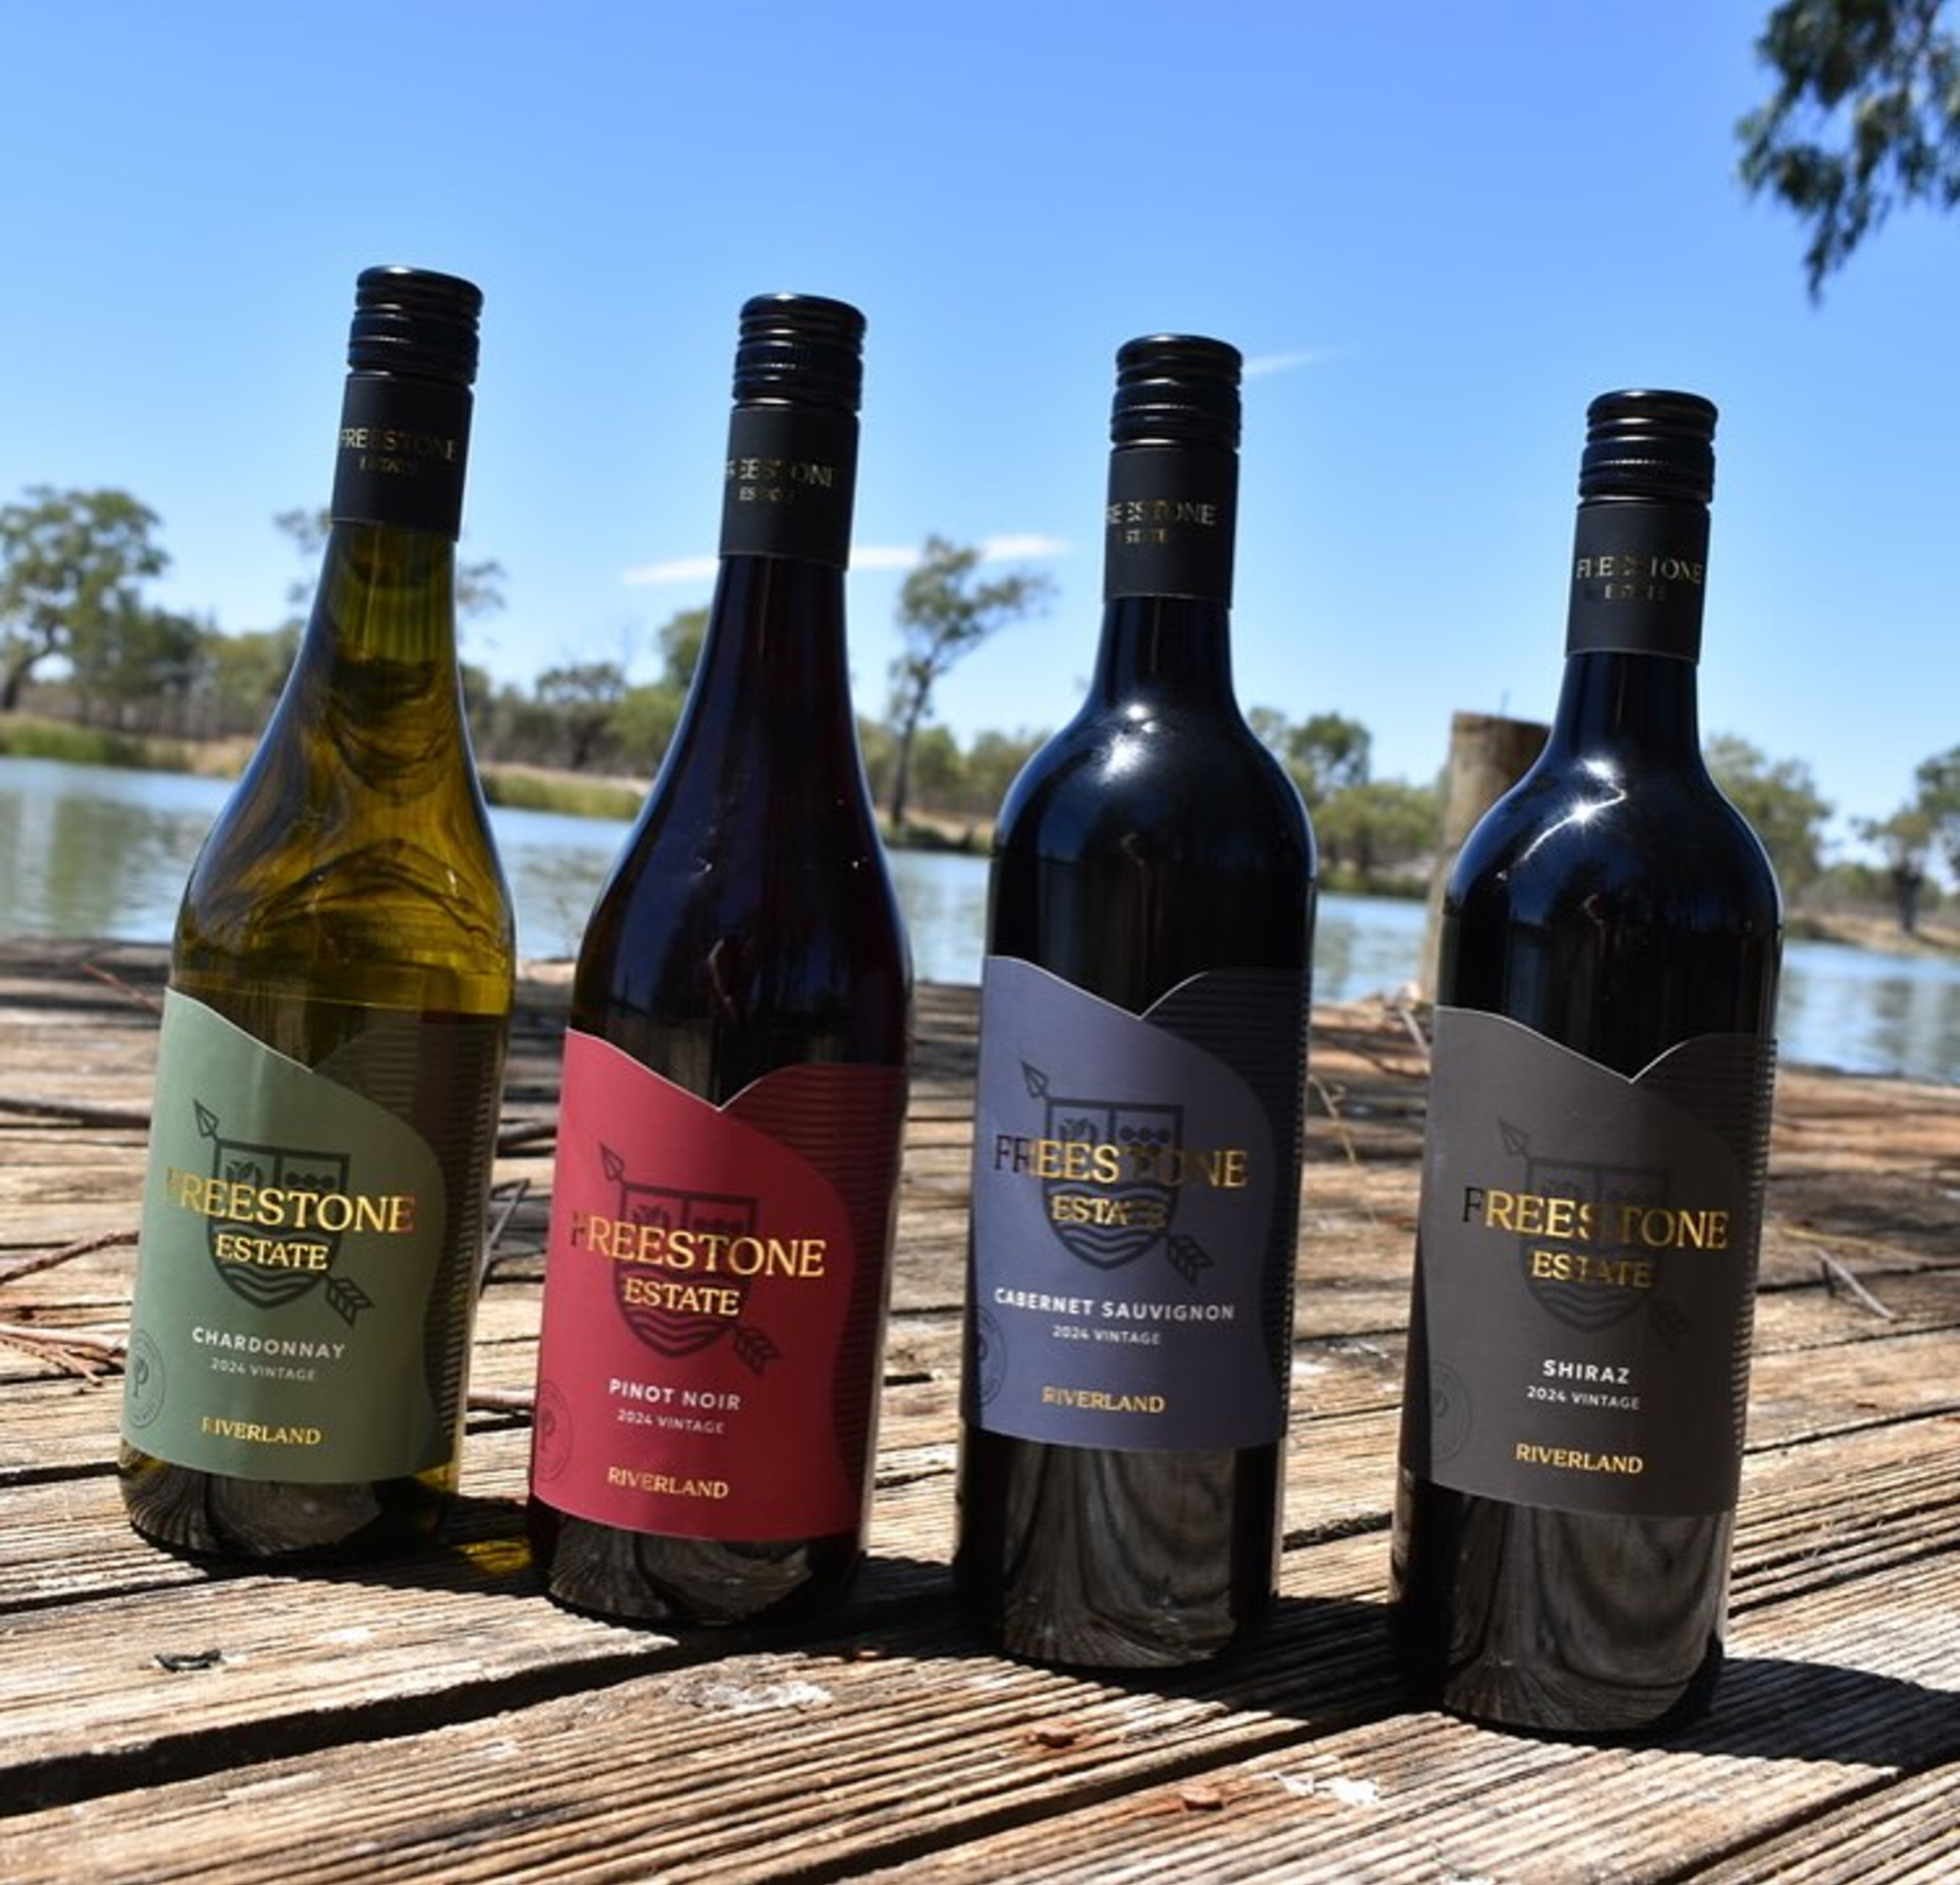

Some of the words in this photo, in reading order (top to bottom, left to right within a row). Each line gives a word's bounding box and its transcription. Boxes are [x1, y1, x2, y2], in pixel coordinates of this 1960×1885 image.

[165, 1166, 416, 1233] FREESTONE
[1463, 1186, 1731, 1250] FREESTONE
[215, 1232, 330, 1270] ESTATE
[570, 1211, 826, 1276] FREESTONE
[1531, 1250, 1654, 1289] ESTATE
[623, 1277, 741, 1315] ESTATE
[994, 1287, 1095, 1315] CABERNET
[1102, 1302, 1236, 1321] SAUVIGNON
[191, 1325, 346, 1360] CHARDONNAY
[1052, 1325, 1090, 1341] 2024
[1093, 1328, 1162, 1346] VINTAGE
[210, 1357, 246, 1374] 2024
[249, 1364, 315, 1381] VINTAGE
[1542, 1359, 1631, 1385] SHIRAZ
[609, 1377, 675, 1404] PINOT
[682, 1391, 742, 1412] NOIR
[1041, 1385, 1166, 1414] RIVERLAND
[1526, 1385, 1567, 1403] 2024
[1571, 1391, 1642, 1411] VINTAGE
[201, 1416, 322, 1446] RIVERLAND
[616, 1409, 654, 1426] 2024
[657, 1416, 725, 1435] VINTAGE
[1515, 1443, 1644, 1474] RIVERLAND
[607, 1466, 730, 1500] RIVERLAND
